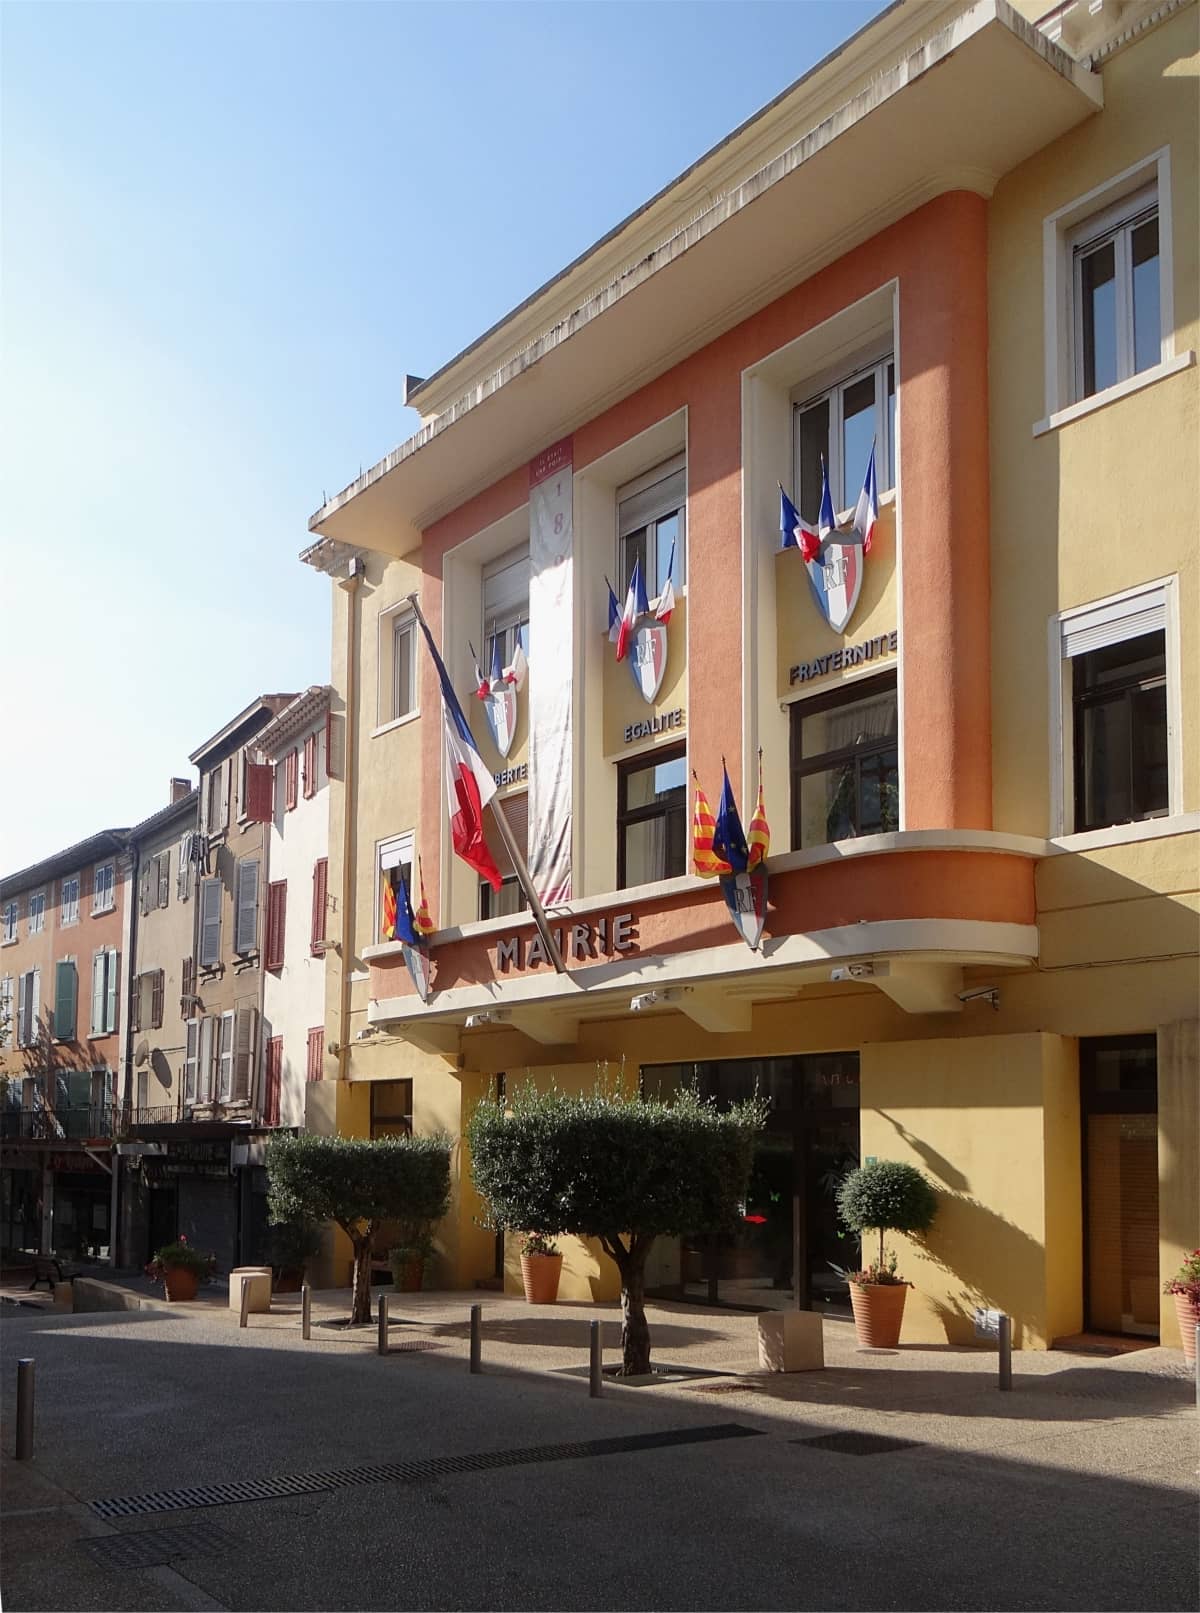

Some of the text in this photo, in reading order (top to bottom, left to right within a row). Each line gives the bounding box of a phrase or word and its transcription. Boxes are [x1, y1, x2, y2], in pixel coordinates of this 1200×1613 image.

[822, 556, 849, 592] RF
[790, 630, 898, 685] FRATERNITE
[624, 708, 682, 743] EGALITE
[493, 763, 527, 786] BERTE
